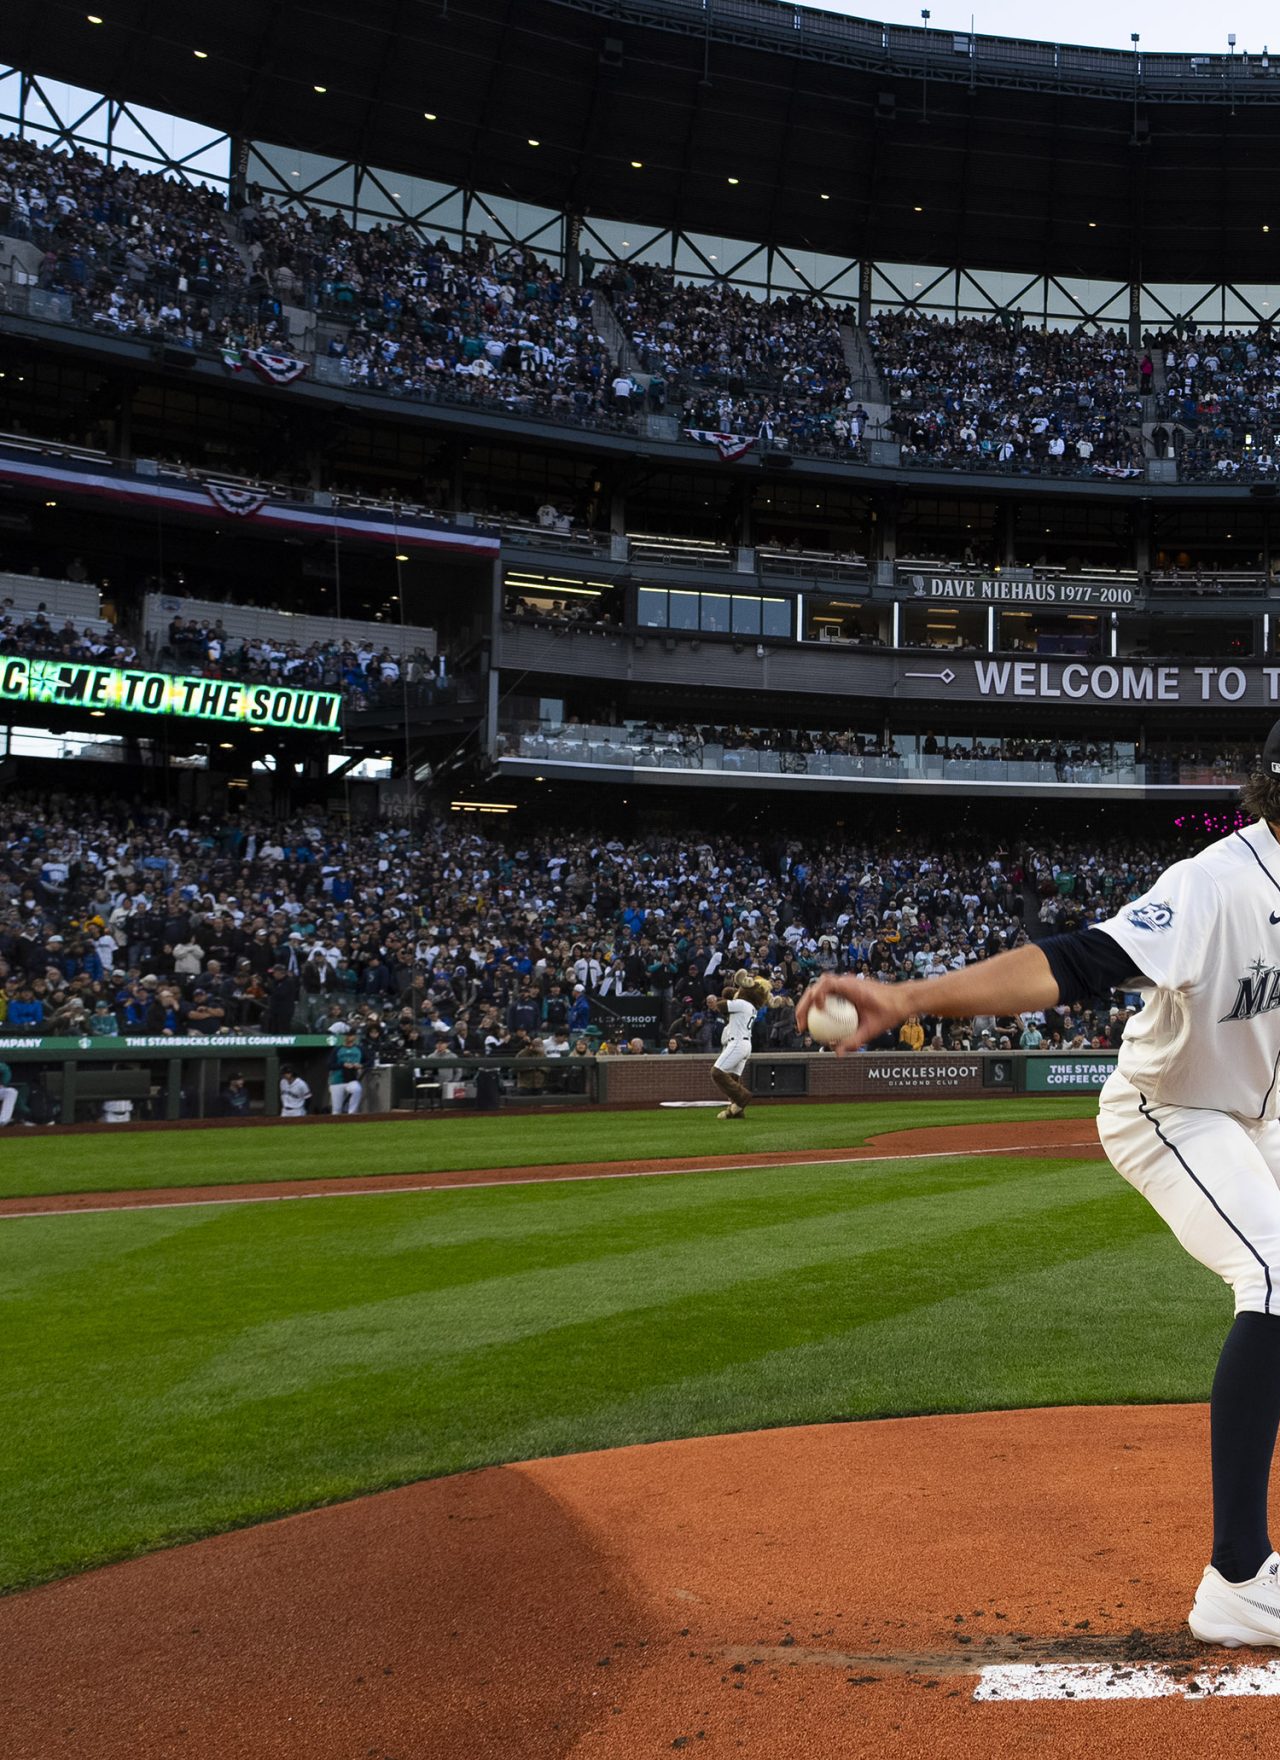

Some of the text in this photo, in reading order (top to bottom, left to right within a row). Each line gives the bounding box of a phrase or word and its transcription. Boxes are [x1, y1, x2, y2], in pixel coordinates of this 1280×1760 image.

[931, 579, 976, 598] DAVE
[981, 581, 1056, 601] NIEHAUS
[974, 660, 1180, 701] WELCOME
[1194, 666, 1247, 701] TO
[122, 673, 166, 710] TO
[181, 678, 241, 718] THE
[250, 688, 342, 728] SOUN
[126, 1036, 296, 1047] THE STARBUCKS COFFEE COMPANY
[868, 1066, 978, 1079] MUCKLESHOOT
[1049, 1064, 1073, 1074] THE
[1047, 1074, 1090, 1084] COFFEE
